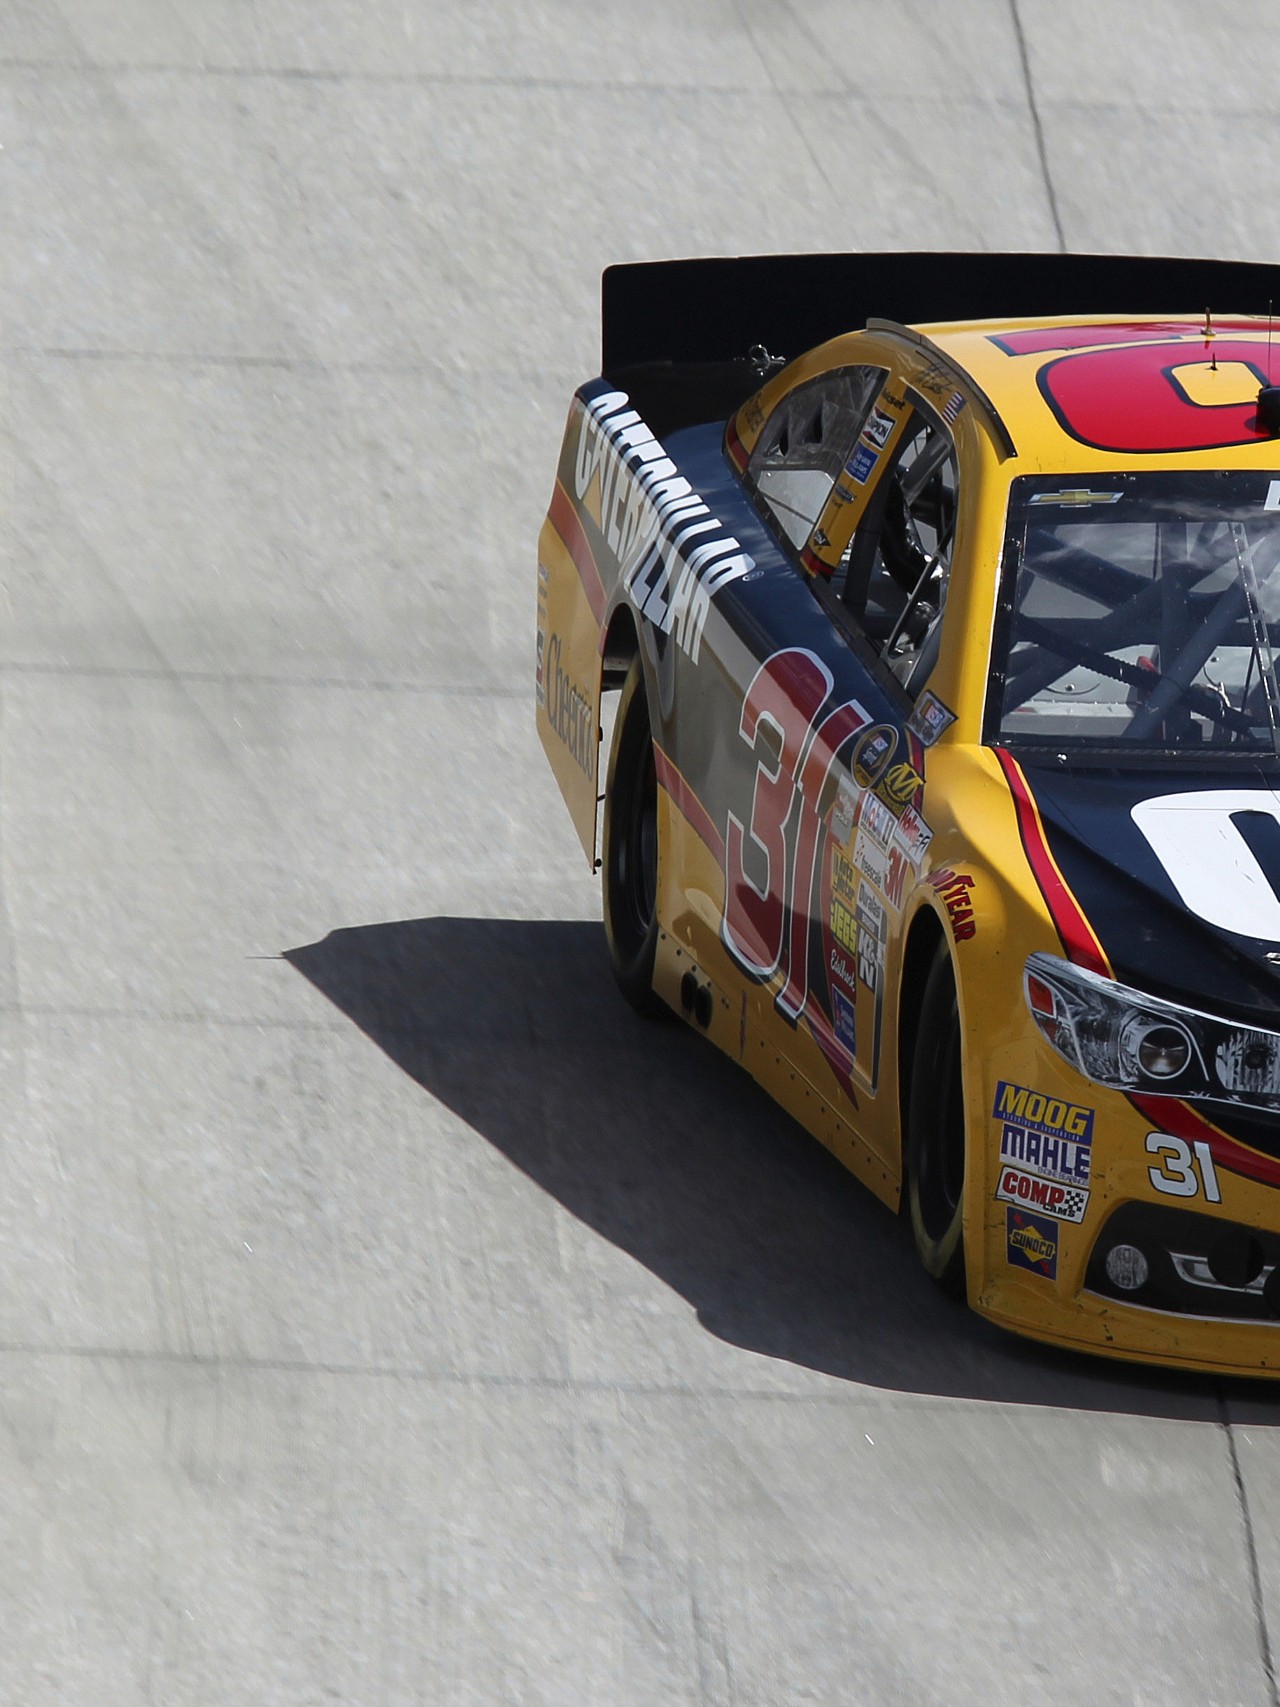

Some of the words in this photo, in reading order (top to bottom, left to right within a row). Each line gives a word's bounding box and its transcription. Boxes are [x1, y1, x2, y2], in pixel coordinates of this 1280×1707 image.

[721, 646, 873, 1020] 31
[884, 845, 910, 910] 3M
[830, 902, 857, 955] JEGS
[999, 1085, 1090, 1136] MOOG
[1001, 1124, 1090, 1179] MAHLE
[1145, 1131, 1221, 1203] 31
[1003, 1172, 1065, 1208] COMP
[1043, 1203, 1075, 1218] CAMS
[1011, 1230, 1055, 1260] SUNOCO
